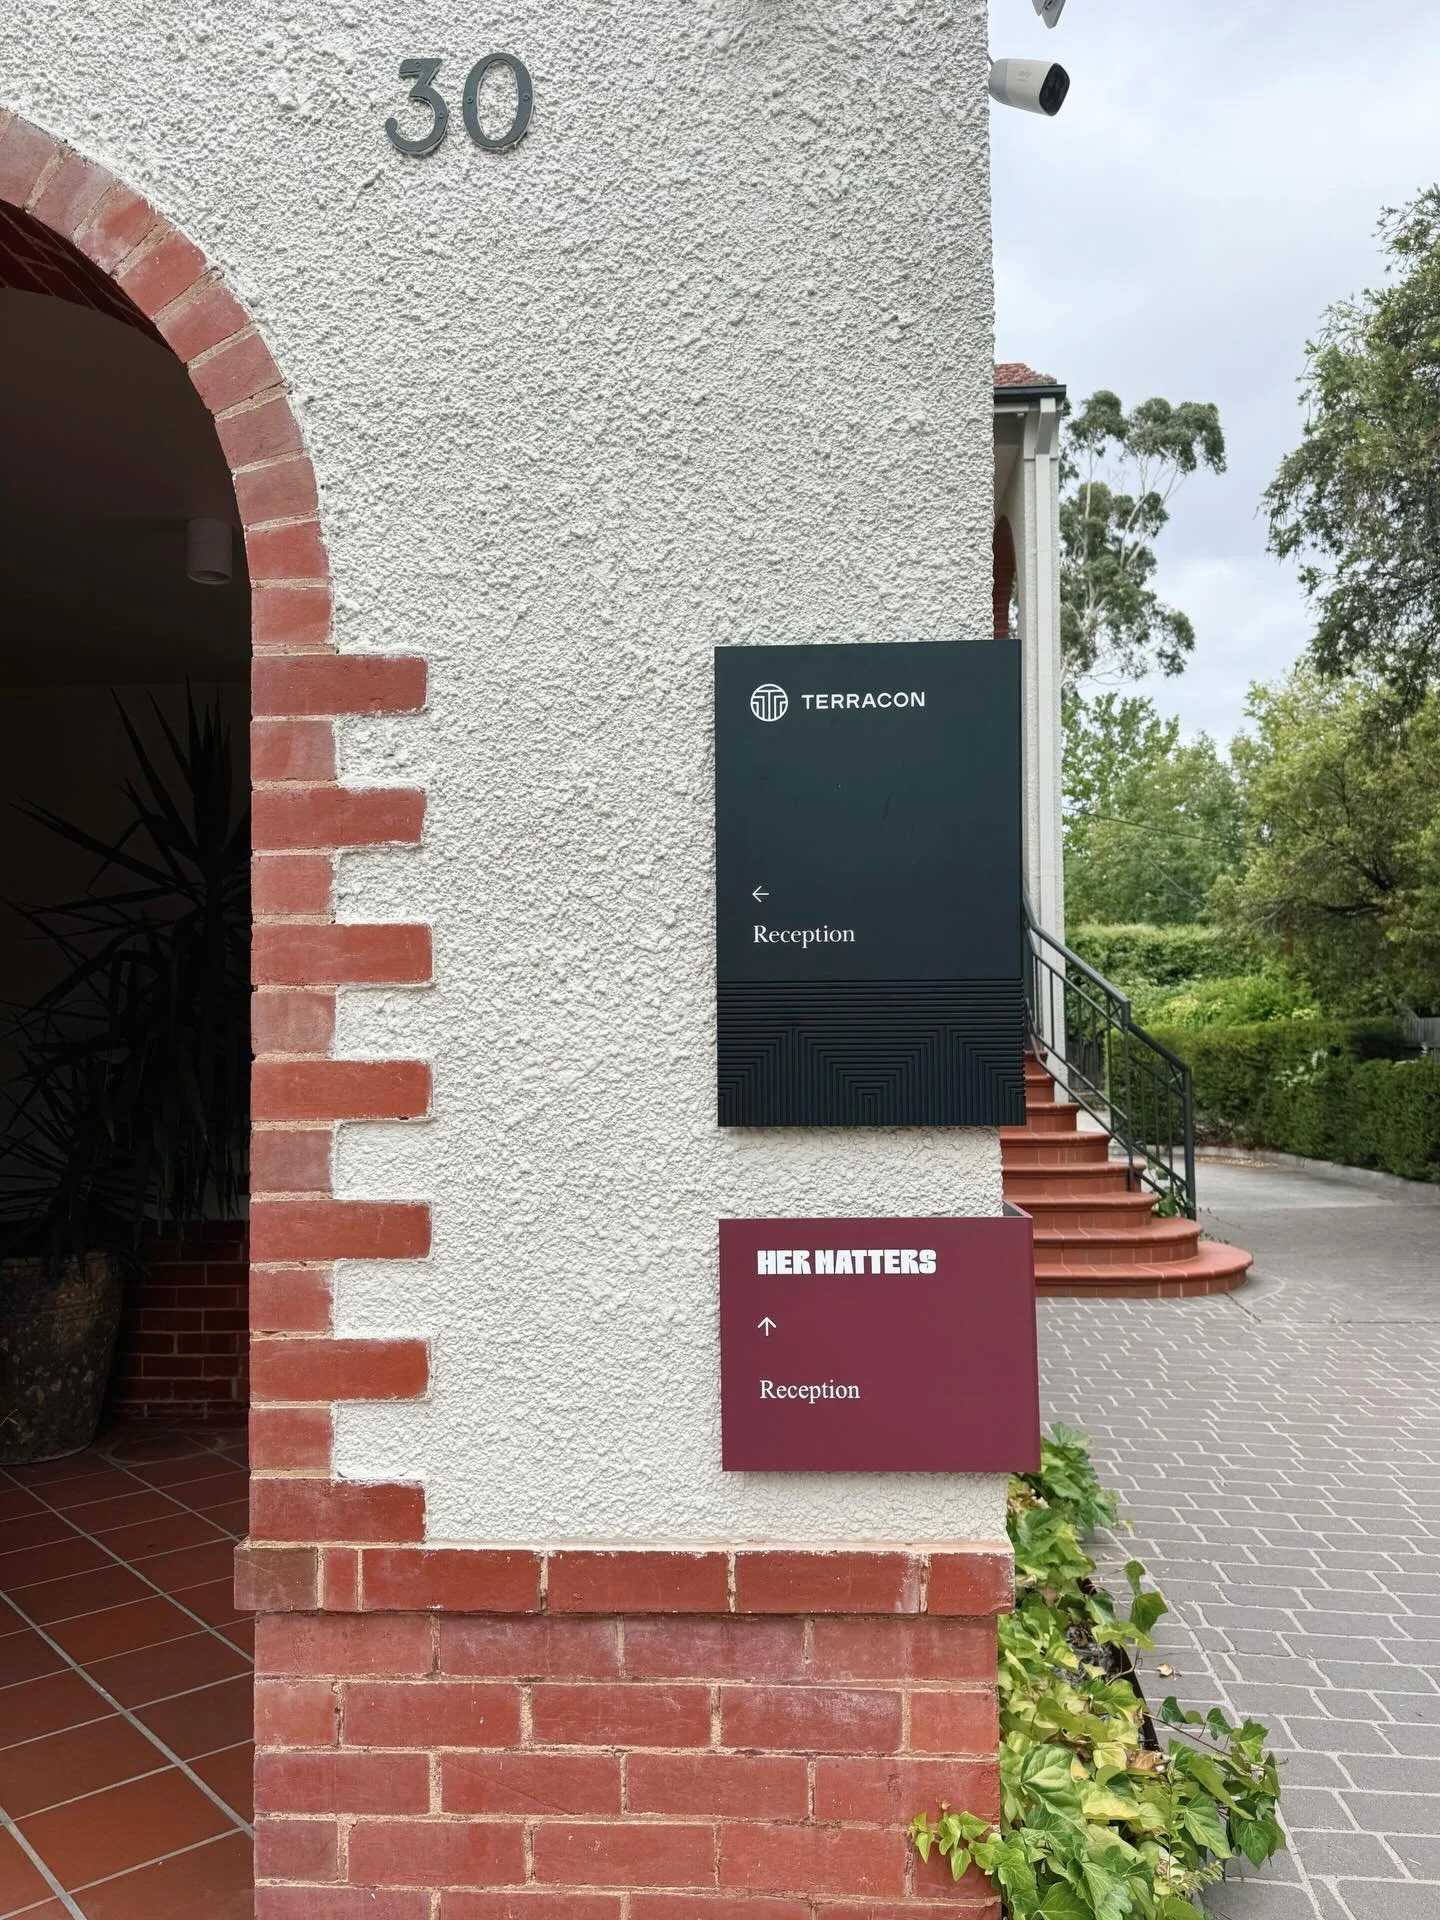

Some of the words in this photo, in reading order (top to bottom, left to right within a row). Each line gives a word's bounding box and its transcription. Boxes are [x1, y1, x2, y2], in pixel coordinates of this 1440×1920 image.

[385, 52, 535, 154] 30
[800, 692, 926, 710] TERRACON
[753, 924, 856, 949] Reception
[756, 1249, 812, 1275] HER
[815, 1249, 937, 1275] MATTERS
[759, 1379, 861, 1405] Reception
